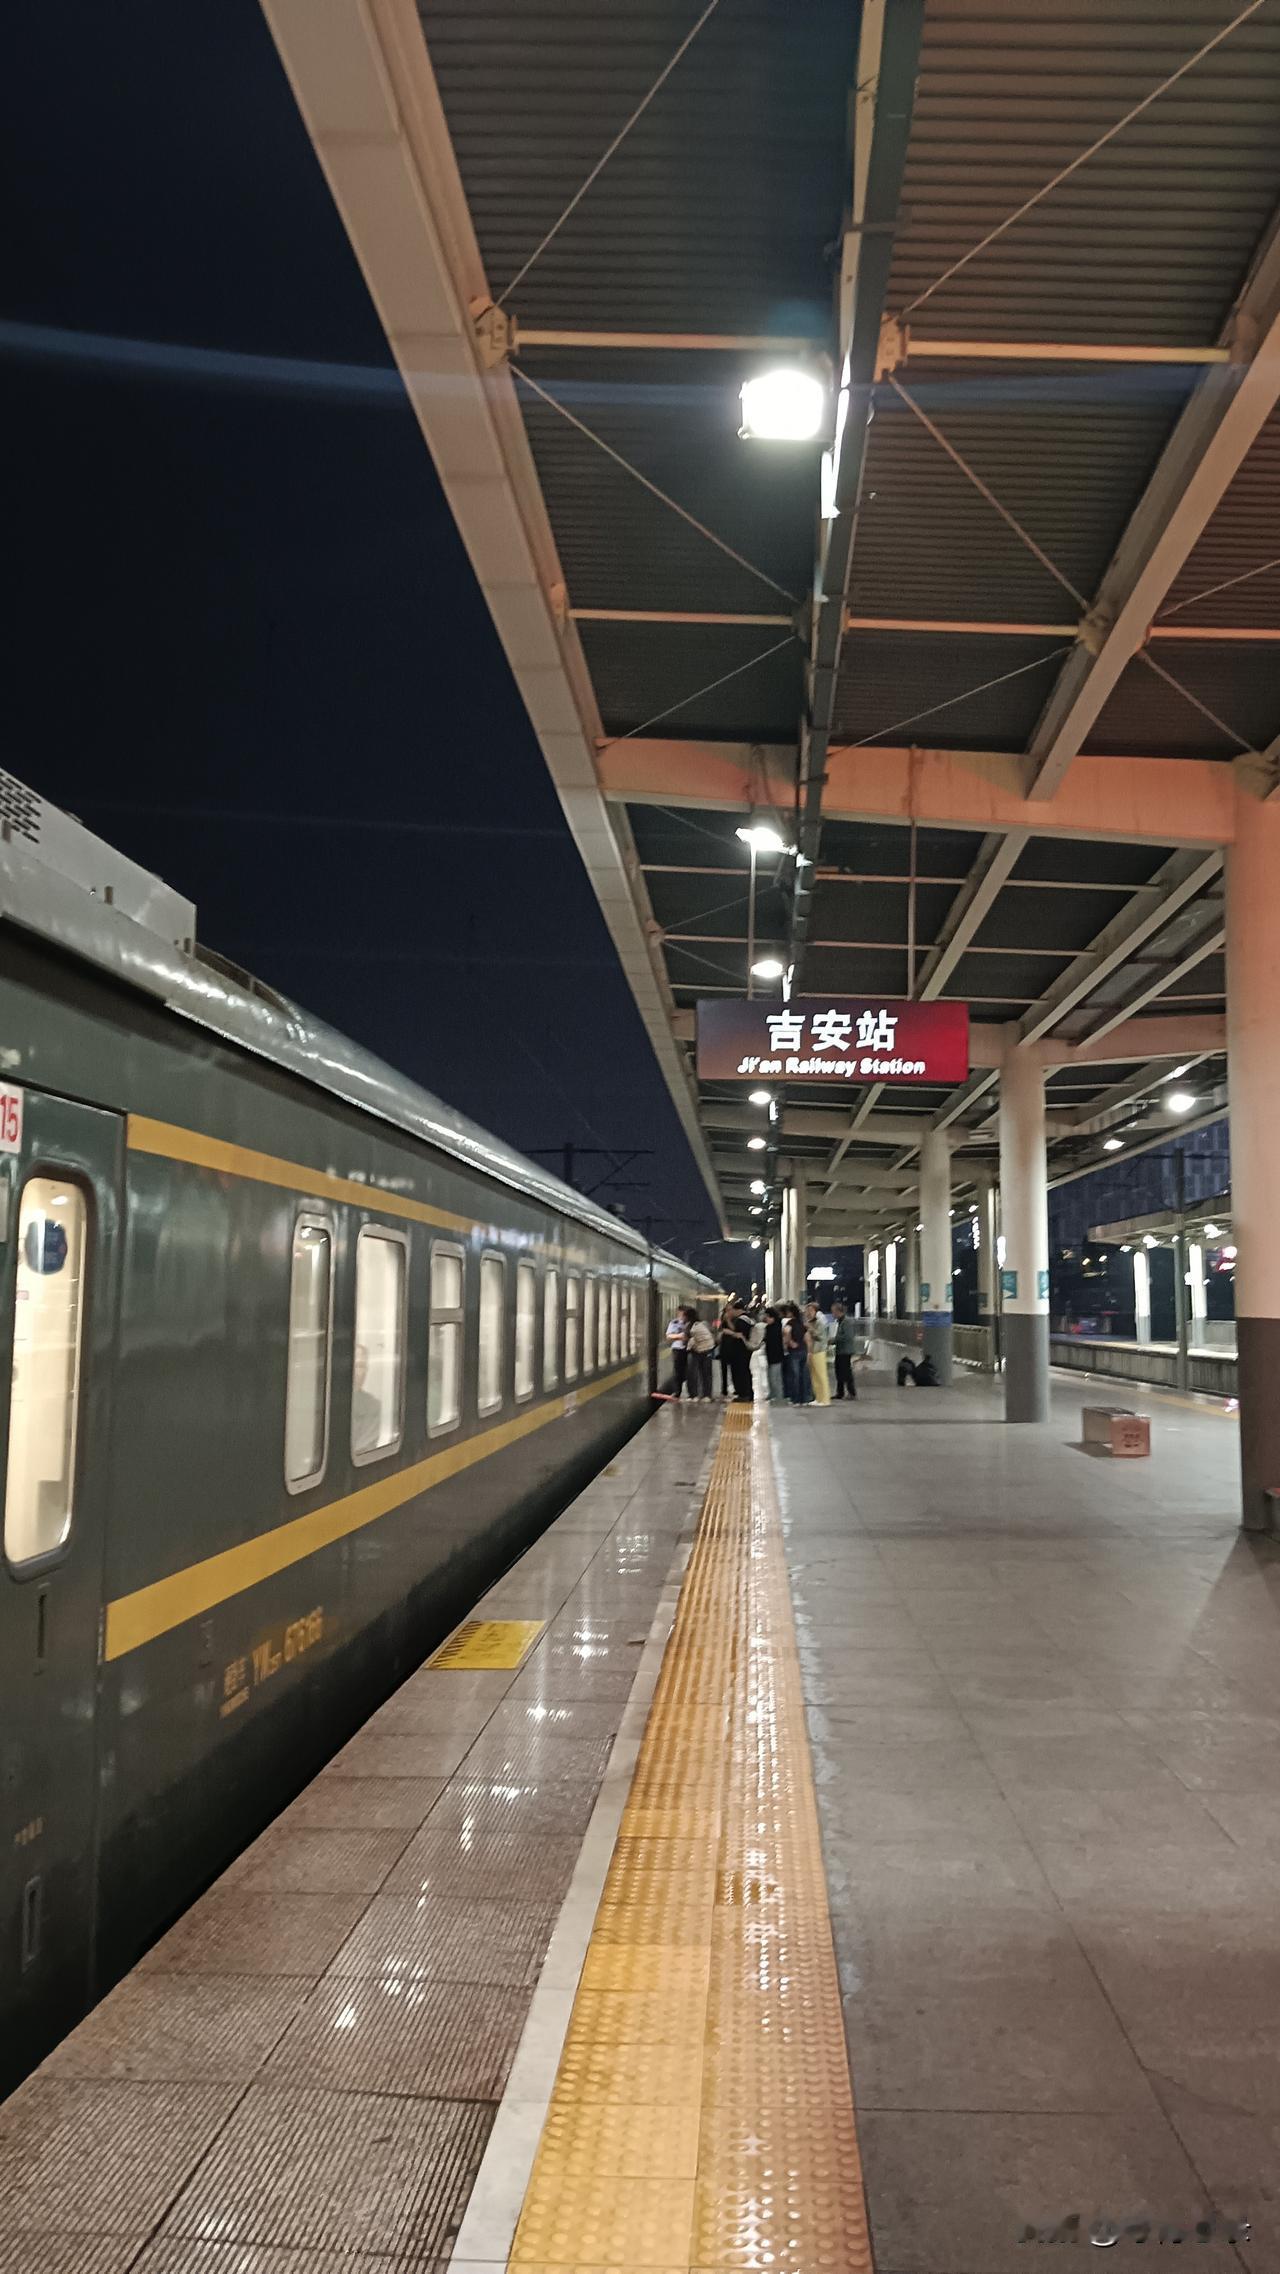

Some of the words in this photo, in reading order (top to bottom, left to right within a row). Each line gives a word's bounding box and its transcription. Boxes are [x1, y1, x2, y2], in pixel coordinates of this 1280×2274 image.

[765, 1009, 899, 1052] 吉安站
[785, 1056, 858, 1078] Railway
[859, 1057, 926, 1075] Station
